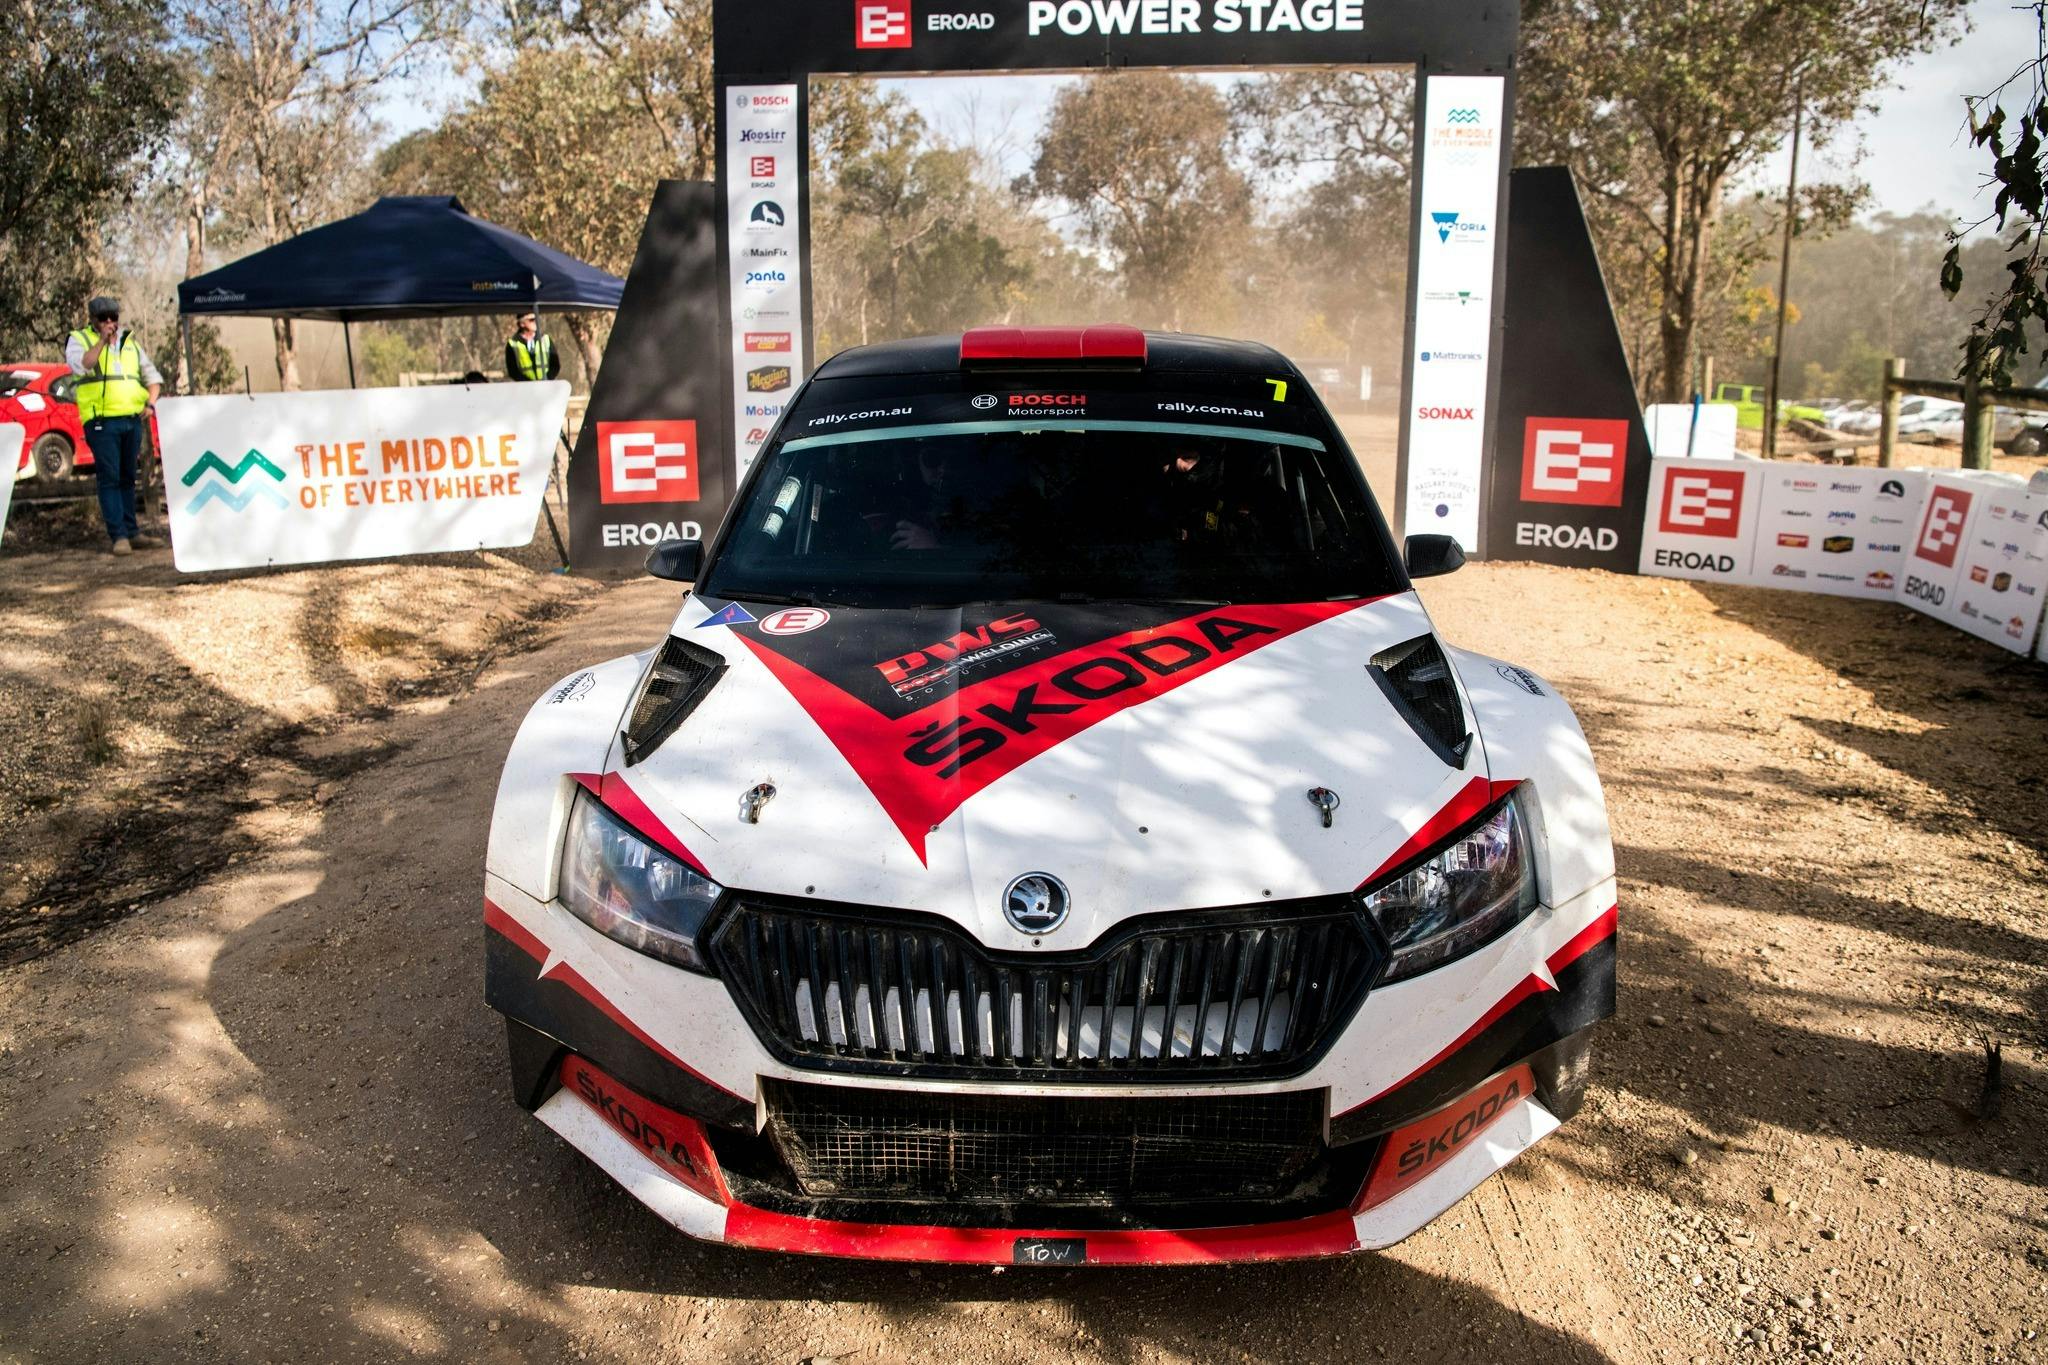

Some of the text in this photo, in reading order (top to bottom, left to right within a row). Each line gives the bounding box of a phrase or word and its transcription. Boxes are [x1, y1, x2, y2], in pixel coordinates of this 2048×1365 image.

[927, 13, 995, 31] EROAD
[1028, 0, 1364, 36] POWER STAGE
[752, 96, 789, 106] BOSCH
[750, 247, 788, 257] MainFix
[745, 270, 786, 285] panta
[1432, 351, 1482, 360] Mattronics
[1008, 395, 1087, 406] BOSCH
[1265, 378, 1287, 402] 7
[746, 405, 779, 416] Mobil
[807, 406, 913, 427] rally.com.au
[1008, 407, 1087, 416] Motorsport
[1157, 402, 1265, 418] rally.com.au
[1418, 408, 1475, 420] SONAX
[295, 434, 519, 478] THE MIDDLE
[301, 472, 522, 509] OF EVERYWHERE
[602, 521, 702, 547] EROAD
[1515, 522, 1618, 551] EROAD
[1654, 549, 1735, 573] EROAD
[1904, 575, 1946, 606] EROAD
[775, 612, 815, 630] E
[873, 612, 1042, 683] PWS
[960, 631, 1052, 664] WELDING
[903, 616, 1281, 781] ŠKODA
[1397, 1079, 1520, 1179] ŠKODA
